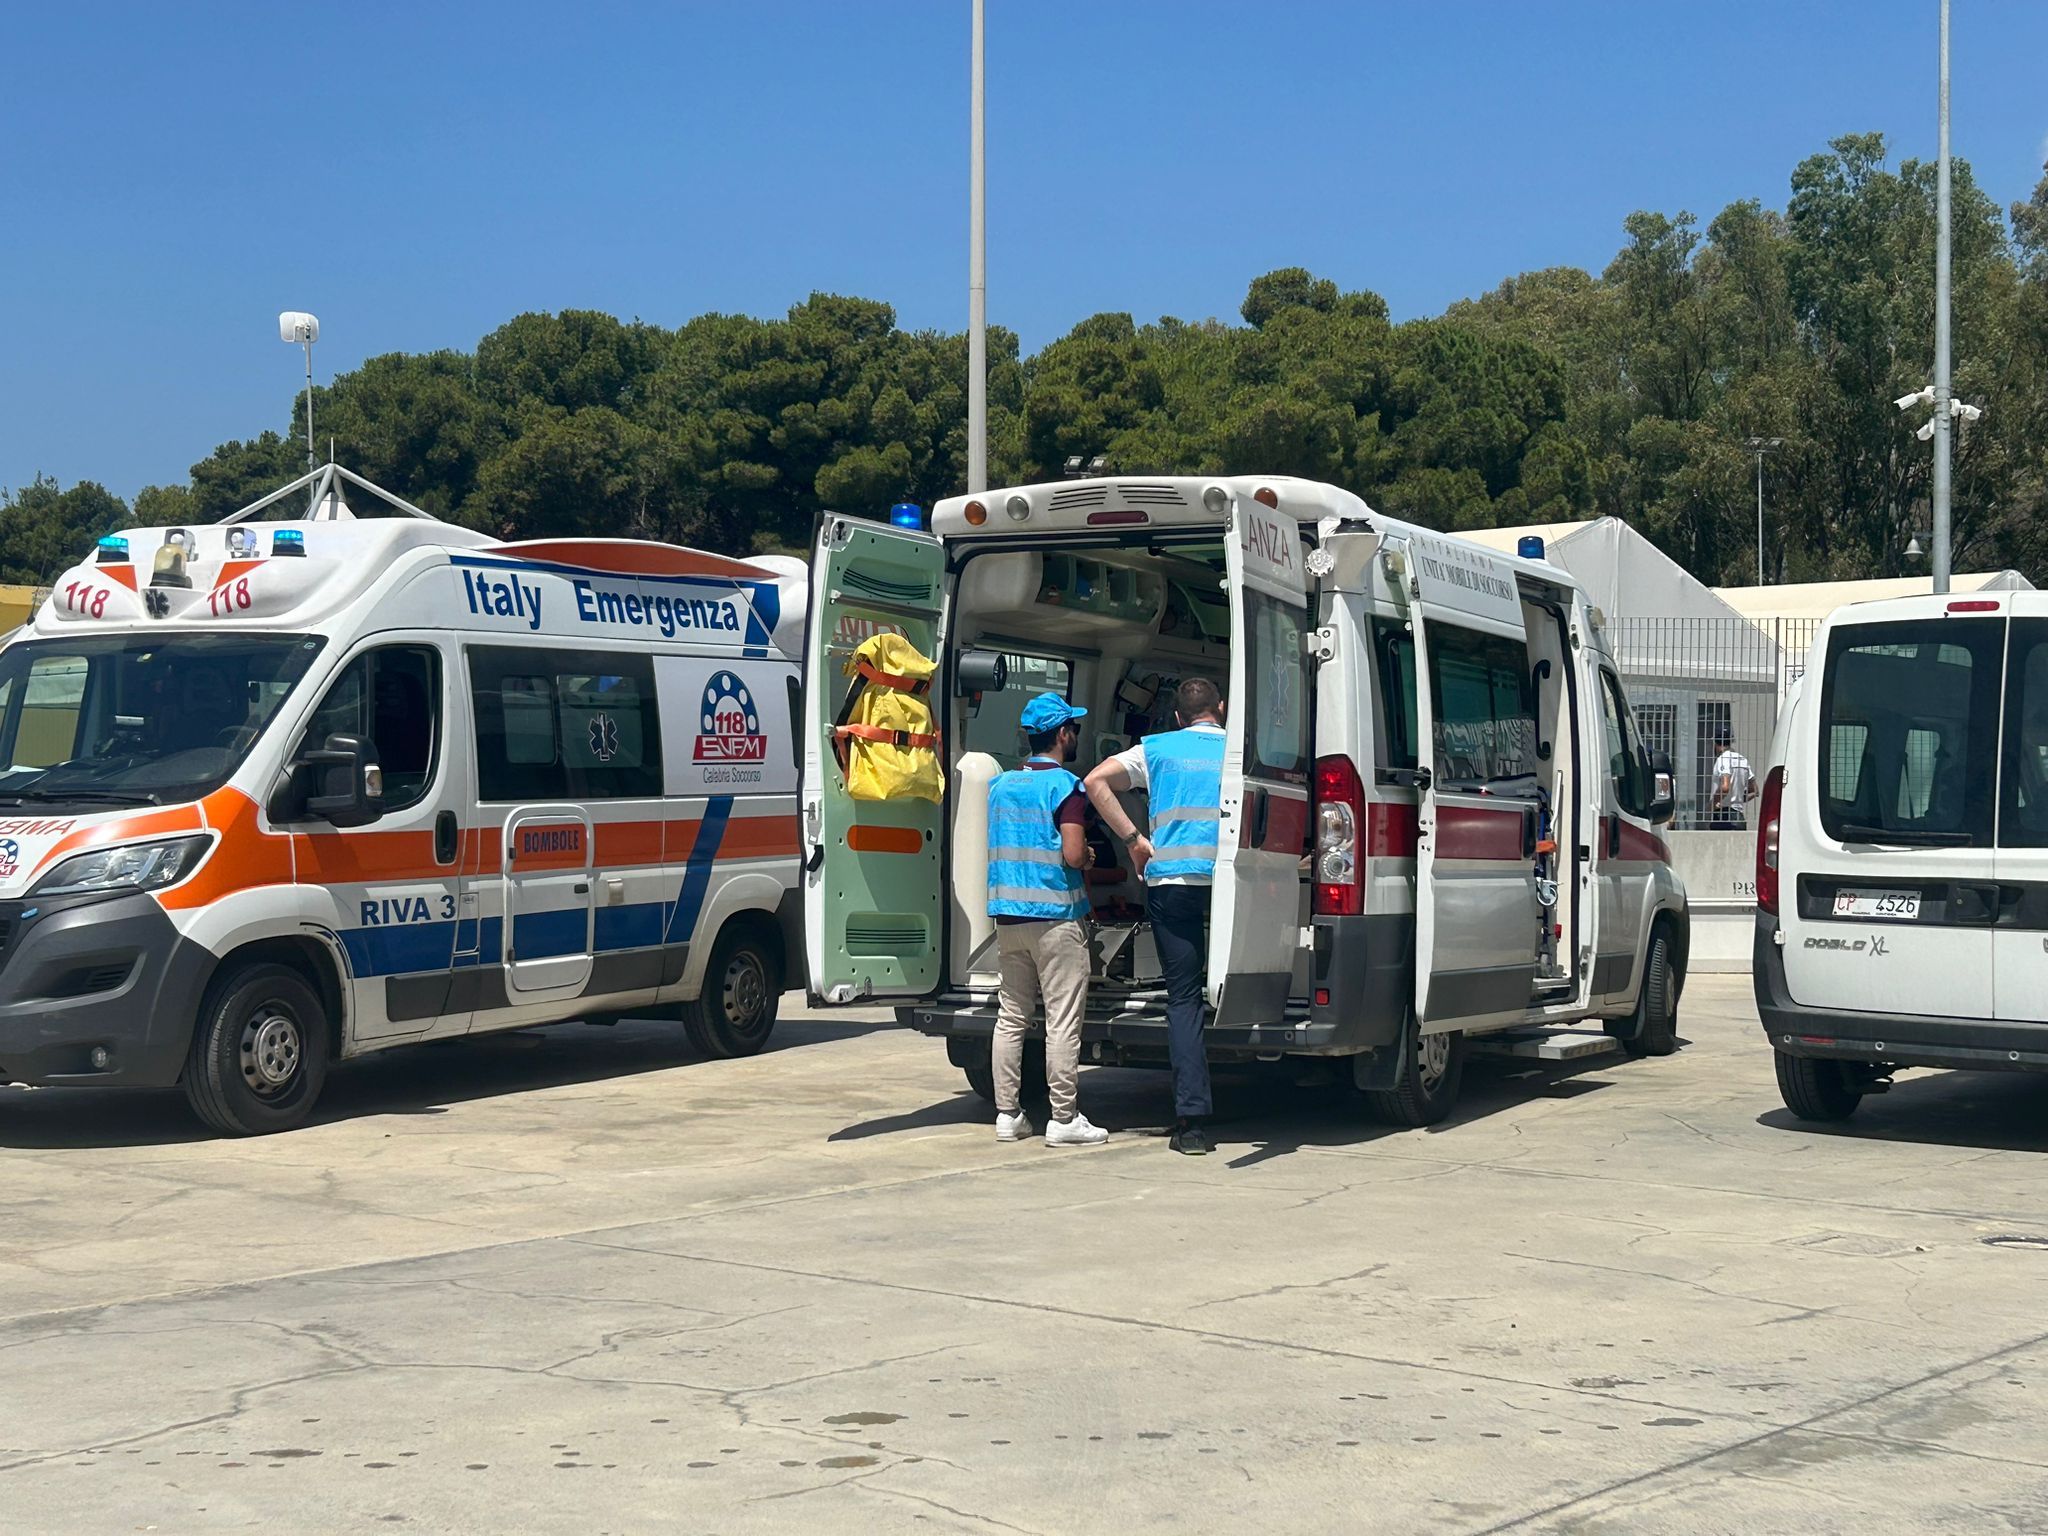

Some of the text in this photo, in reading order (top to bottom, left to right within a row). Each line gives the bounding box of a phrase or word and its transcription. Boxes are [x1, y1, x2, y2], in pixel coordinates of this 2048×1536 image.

[1241, 514, 1292, 570] ANZA
[65, 581, 110, 619] 118
[207, 577, 251, 617] 118
[462, 569, 740, 638] Italy Emergenza
[716, 712, 745, 734] 118
[732, 767, 761, 783] Soccorso
[524, 829, 579, 853] BOMBOLE
[360, 894, 456, 926] RIVA 3
[1837, 893, 1916, 913] CP 4526
[1869, 935, 1890, 957] XL
